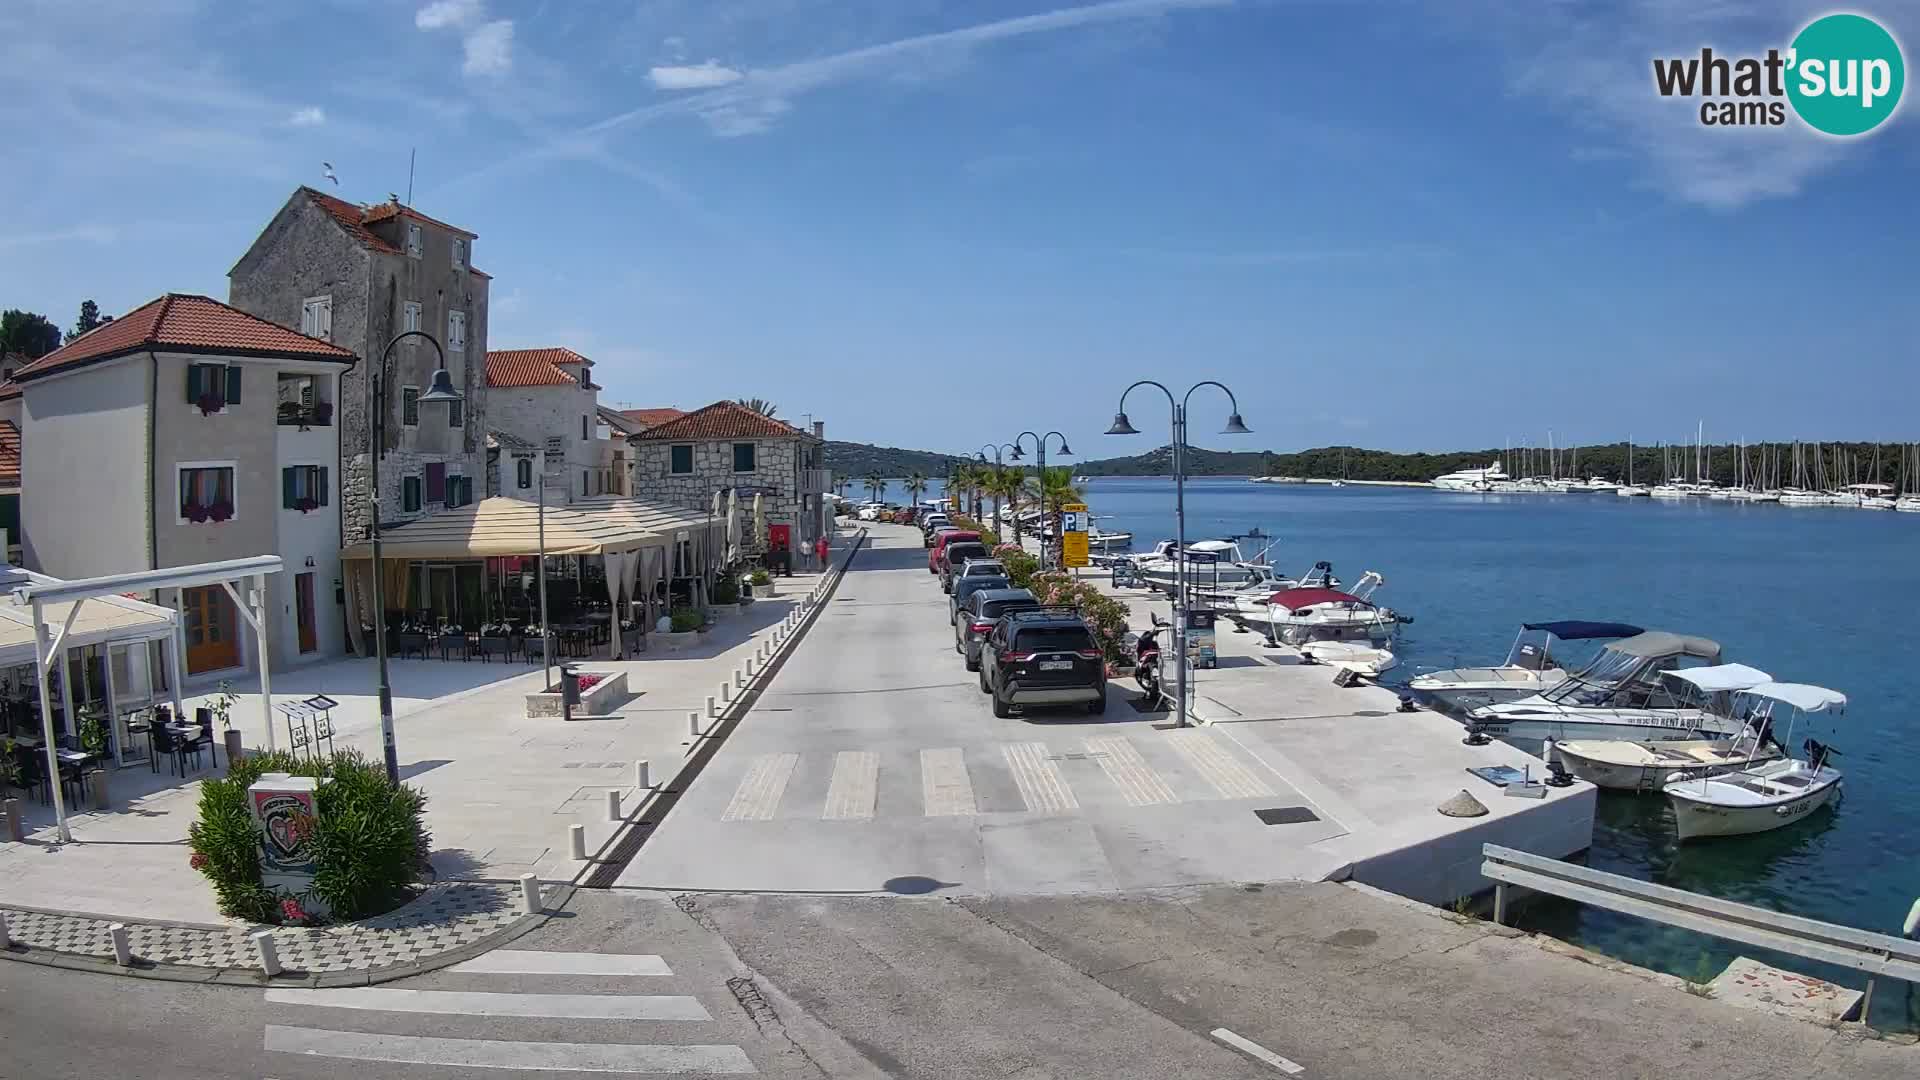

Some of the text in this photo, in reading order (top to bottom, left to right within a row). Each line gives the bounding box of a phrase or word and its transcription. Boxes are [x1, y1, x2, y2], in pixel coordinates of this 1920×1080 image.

[1065, 514, 1075, 530] P
[1660, 718, 1680, 728] RENT
[1686, 719, 1705, 729] BOAT
